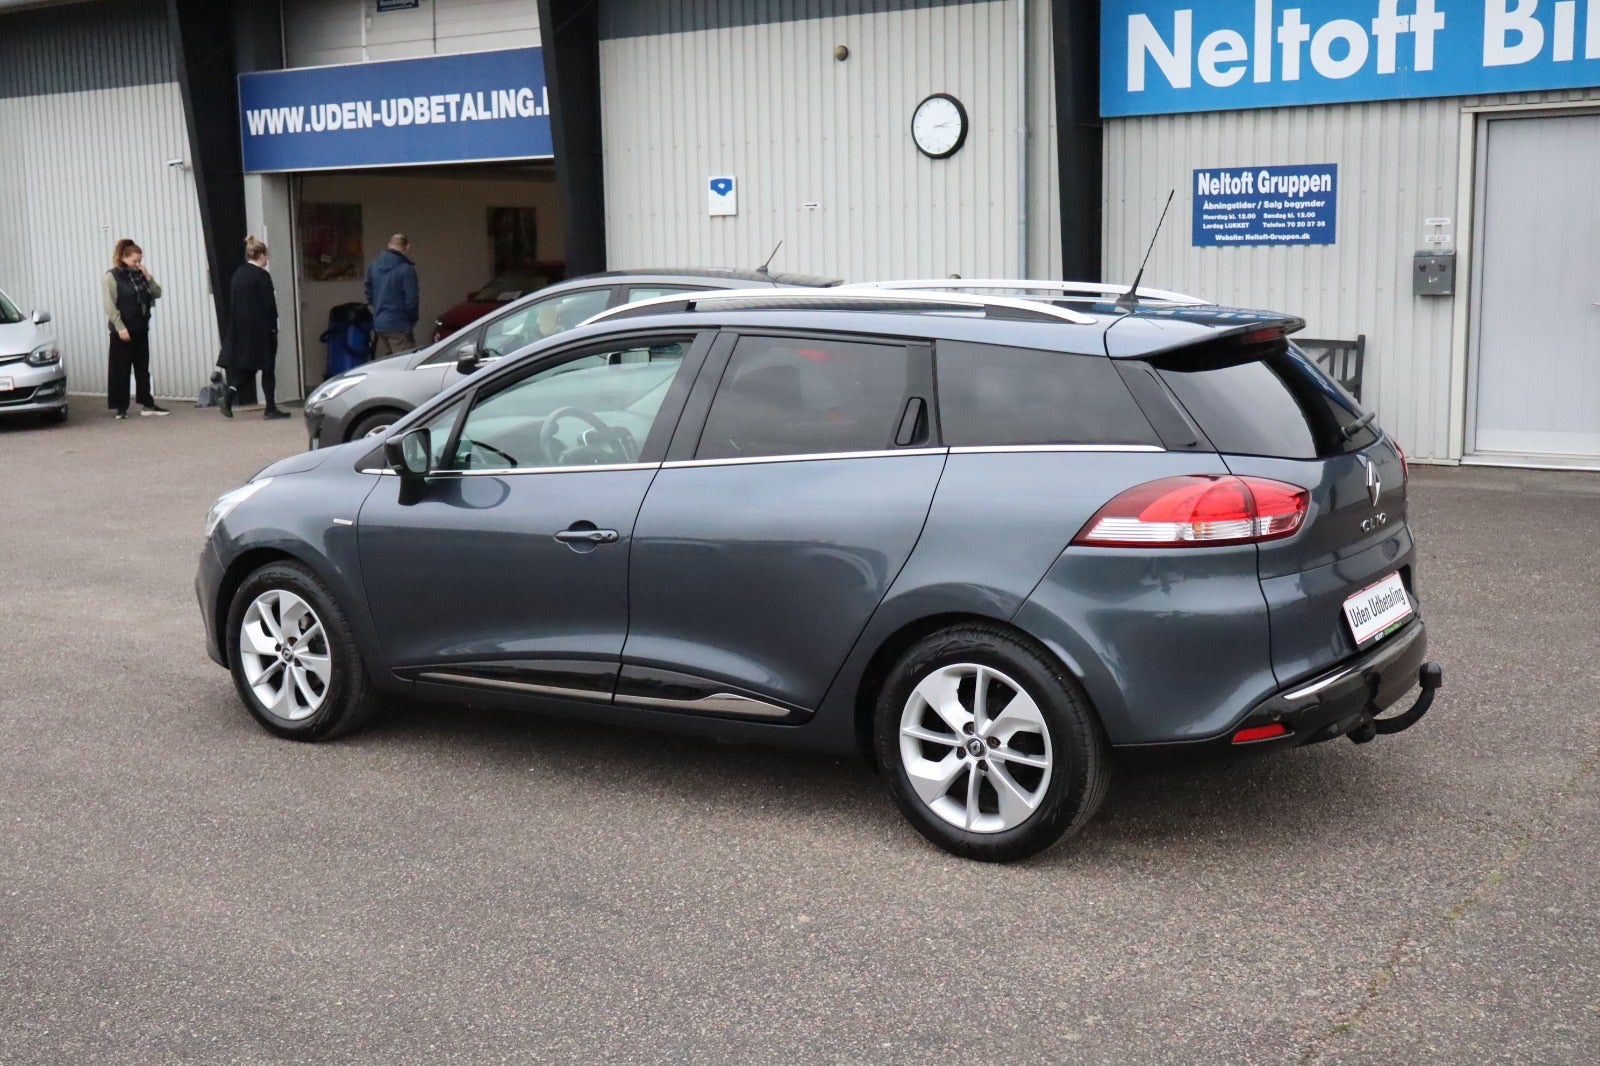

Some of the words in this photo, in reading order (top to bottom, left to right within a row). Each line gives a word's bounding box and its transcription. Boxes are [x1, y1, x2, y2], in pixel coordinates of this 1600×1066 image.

[1127, 0, 1445, 92] Neltoft
[246, 86, 549, 135] WWW.UDEN-UDBETALING.
[1198, 171, 1254, 196] Neltoft
[1257, 170, 1332, 197] Gruppen
[1263, 201, 1282, 209] Salg
[1245, 233, 1310, 241] Neltoft-Gruppen.dk
[1362, 512, 1386, 531] CLIO
[1349, 605, 1371, 627] Uden
[1368, 586, 1406, 617] Udbetaling
